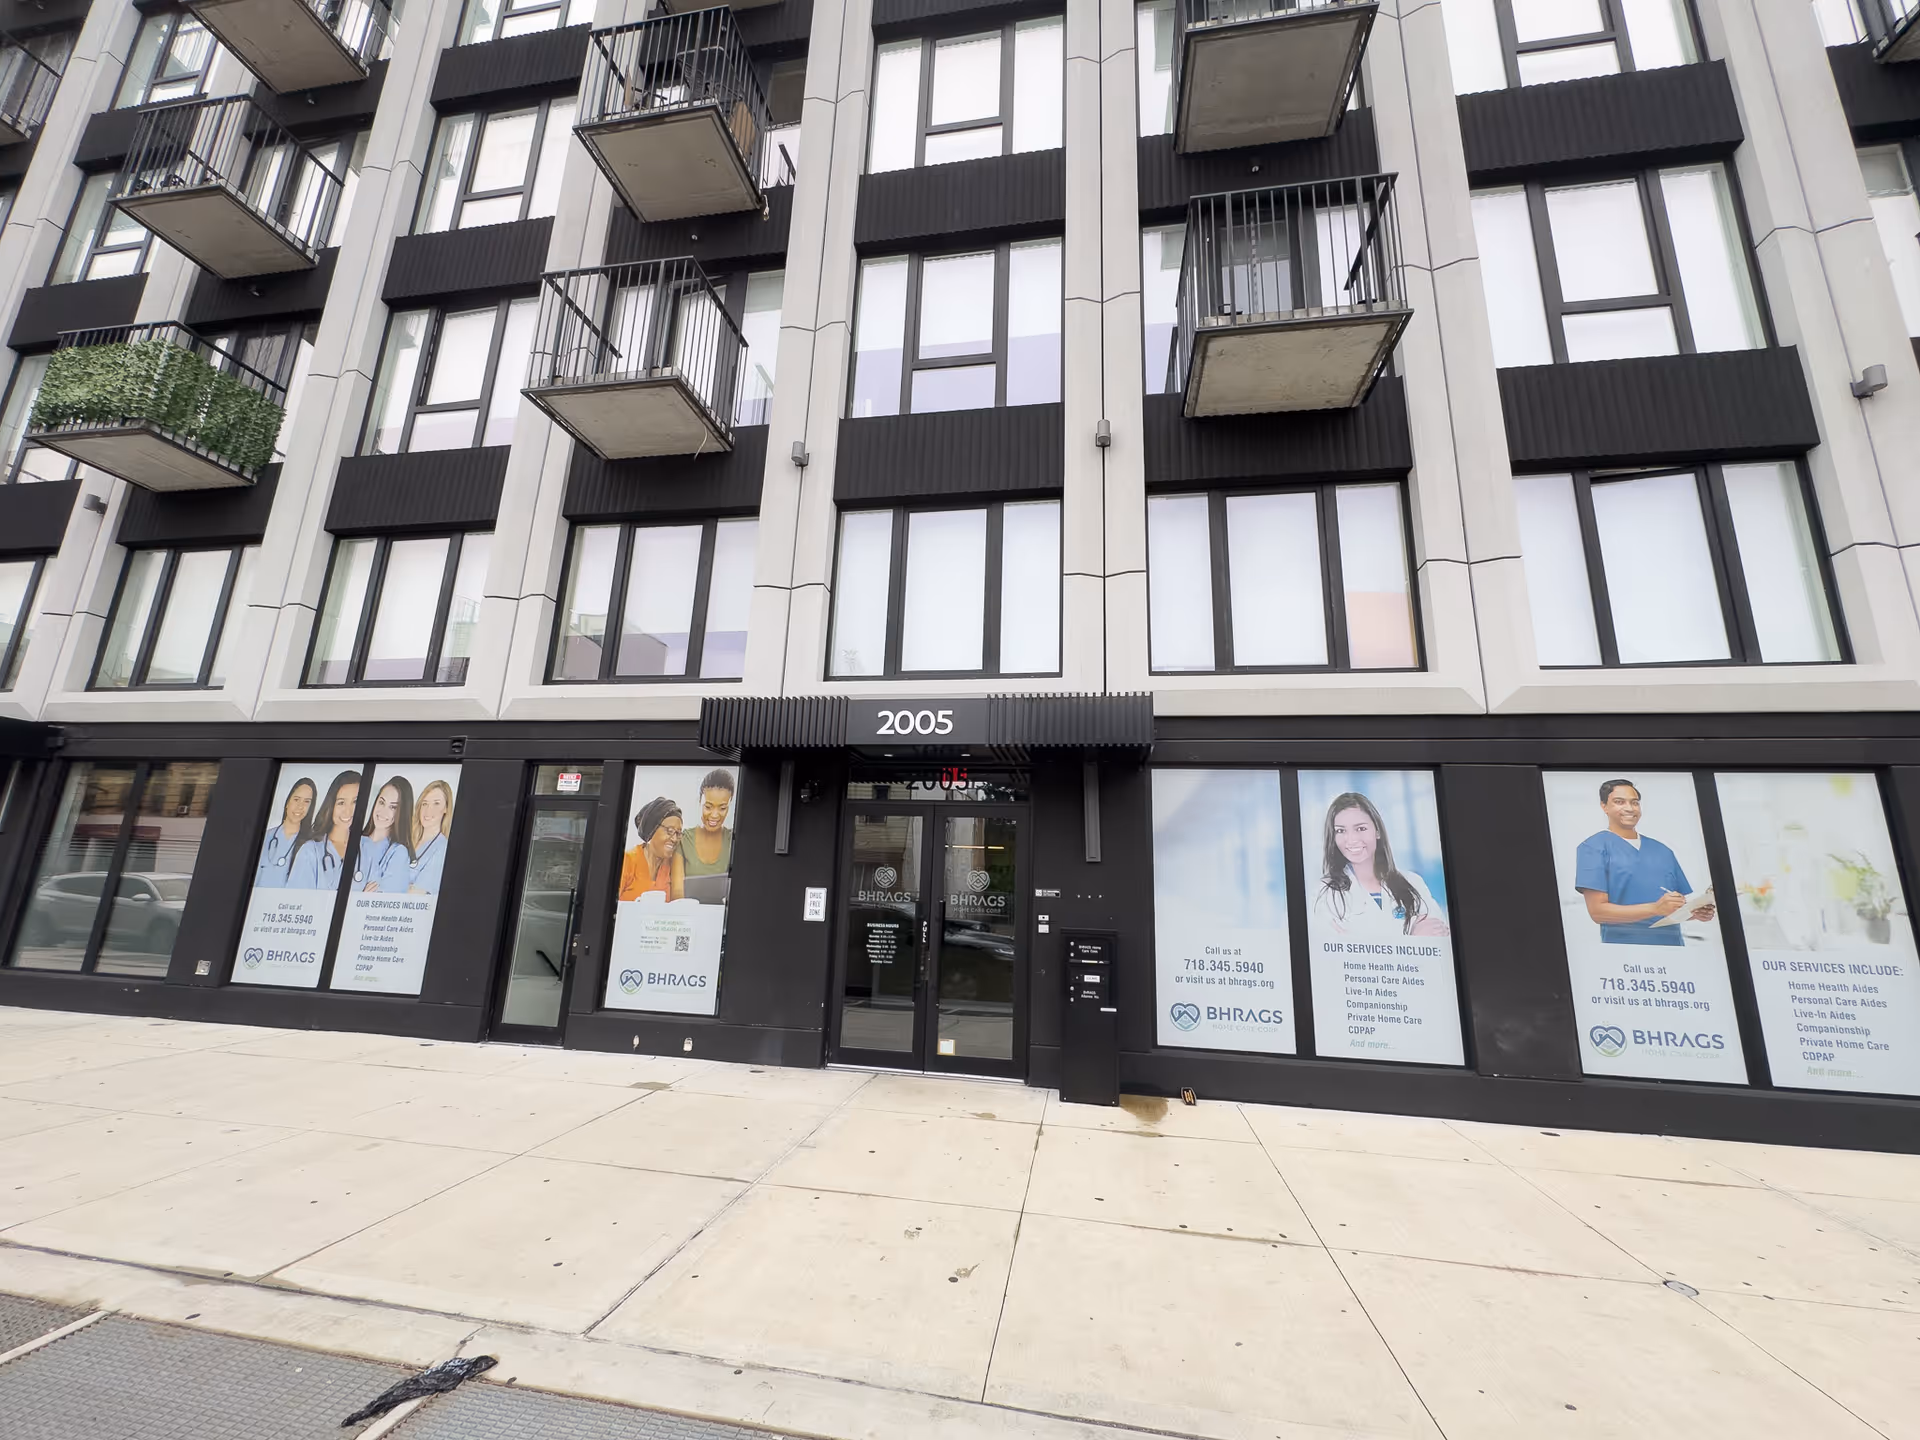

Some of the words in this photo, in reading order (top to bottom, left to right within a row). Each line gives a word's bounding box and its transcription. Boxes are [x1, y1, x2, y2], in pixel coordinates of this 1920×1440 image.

[876, 710, 953, 734] 2005
[858, 890, 911, 902] BHRAGS
[950, 895, 1005, 907] BHRAGS
[371, 901, 400, 909] SERVICES
[262, 913, 313, 924] 718.345.5940
[287, 927, 316, 936] bhrags.org
[360, 944, 398, 953] Companionship
[1205, 946, 1220, 955] Call
[1324, 942, 1344, 952] OUR
[1346, 944, 1393, 954] SERVICES
[1396, 946, 1441, 957] INCLUDE:
[266, 950, 316, 963] BHRAGS
[1184, 959, 1264, 974] 718.345.5940
[1344, 962, 1366, 970] Home
[1368, 963, 1394, 971] Health
[1396, 964, 1419, 972] Aides
[1623, 964, 1641, 973] Call
[1644, 966, 1655, 974] us
[1762, 960, 1786, 971] OUR
[1790, 962, 1845, 973] SERVICES
[1849, 964, 1904, 976] INCLUDE:
[648, 972, 706, 987] BHRAGS
[1186, 975, 1204, 984] visit
[1218, 977, 1226, 985] at
[1228, 977, 1274, 989] bhrags.org
[1344, 974, 1379, 983] Personal
[1381, 976, 1399, 984] Care
[1402, 977, 1425, 986] Aides
[1345, 987, 1373, 996] Live-In
[1375, 988, 1398, 997] Aides
[1600, 978, 1695, 994] 718.345.5940
[1788, 981, 1815, 990] Home
[1818, 982, 1849, 992] Health
[1852, 984, 1879, 993] Aides
[1346, 1000, 1408, 1012] Companionship
[1604, 996, 1625, 1005] visit
[1642, 998, 1652, 1006] at
[1655, 998, 1710, 1011] bhrags.org
[1791, 995, 1832, 1005] Personal
[1836, 997, 1857, 1006] Care
[1860, 998, 1887, 1008] Aides
[1207, 1006, 1283, 1024] BHRAGS
[1347, 1013, 1375, 1022] Private
[1378, 1014, 1401, 1024] Home
[1404, 1016, 1422, 1025] Care
[1794, 1009, 1827, 1019] Live-In
[1830, 1011, 1856, 1020] Aides
[1348, 1026, 1376, 1035] CDPAP
[1796, 1023, 1871, 1036] Companionship
[1350, 1039, 1365, 1047] And
[1632, 1029, 1725, 1050] BHRAGS
[1800, 1037, 1833, 1048] Private
[1836, 1040, 1864, 1049] Home
[1867, 1041, 1889, 1050] Care
[1802, 1052, 1835, 1061] CDPAP
